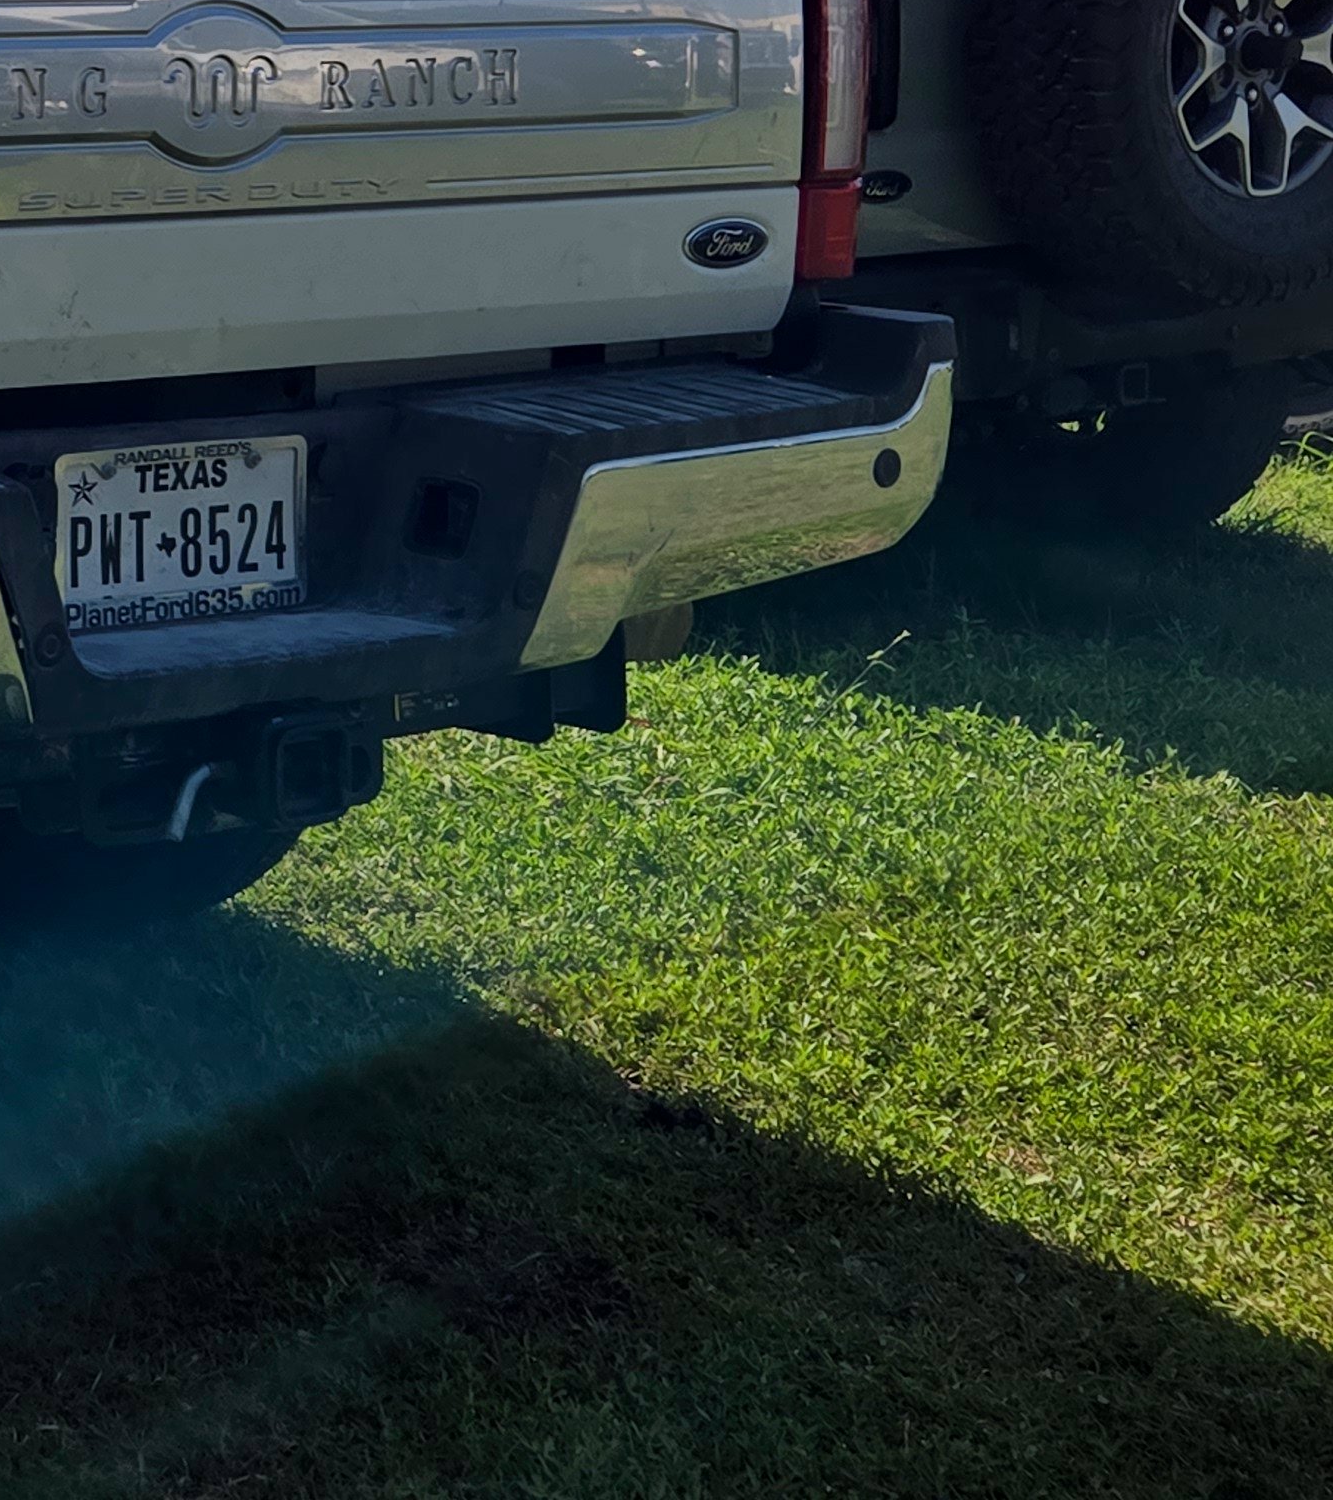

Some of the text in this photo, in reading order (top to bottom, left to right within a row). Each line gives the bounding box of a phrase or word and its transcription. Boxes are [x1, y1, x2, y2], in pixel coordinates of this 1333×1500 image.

[318, 48, 521, 112] RANCH
[17, 177, 400, 213] SUPER DUTY
[706, 228, 754, 257] Ford
[113, 440, 253, 466] RANDALL REED'S
[134, 458, 228, 494] TEXAS
[64, 586, 302, 629] PlanetFord635.com
